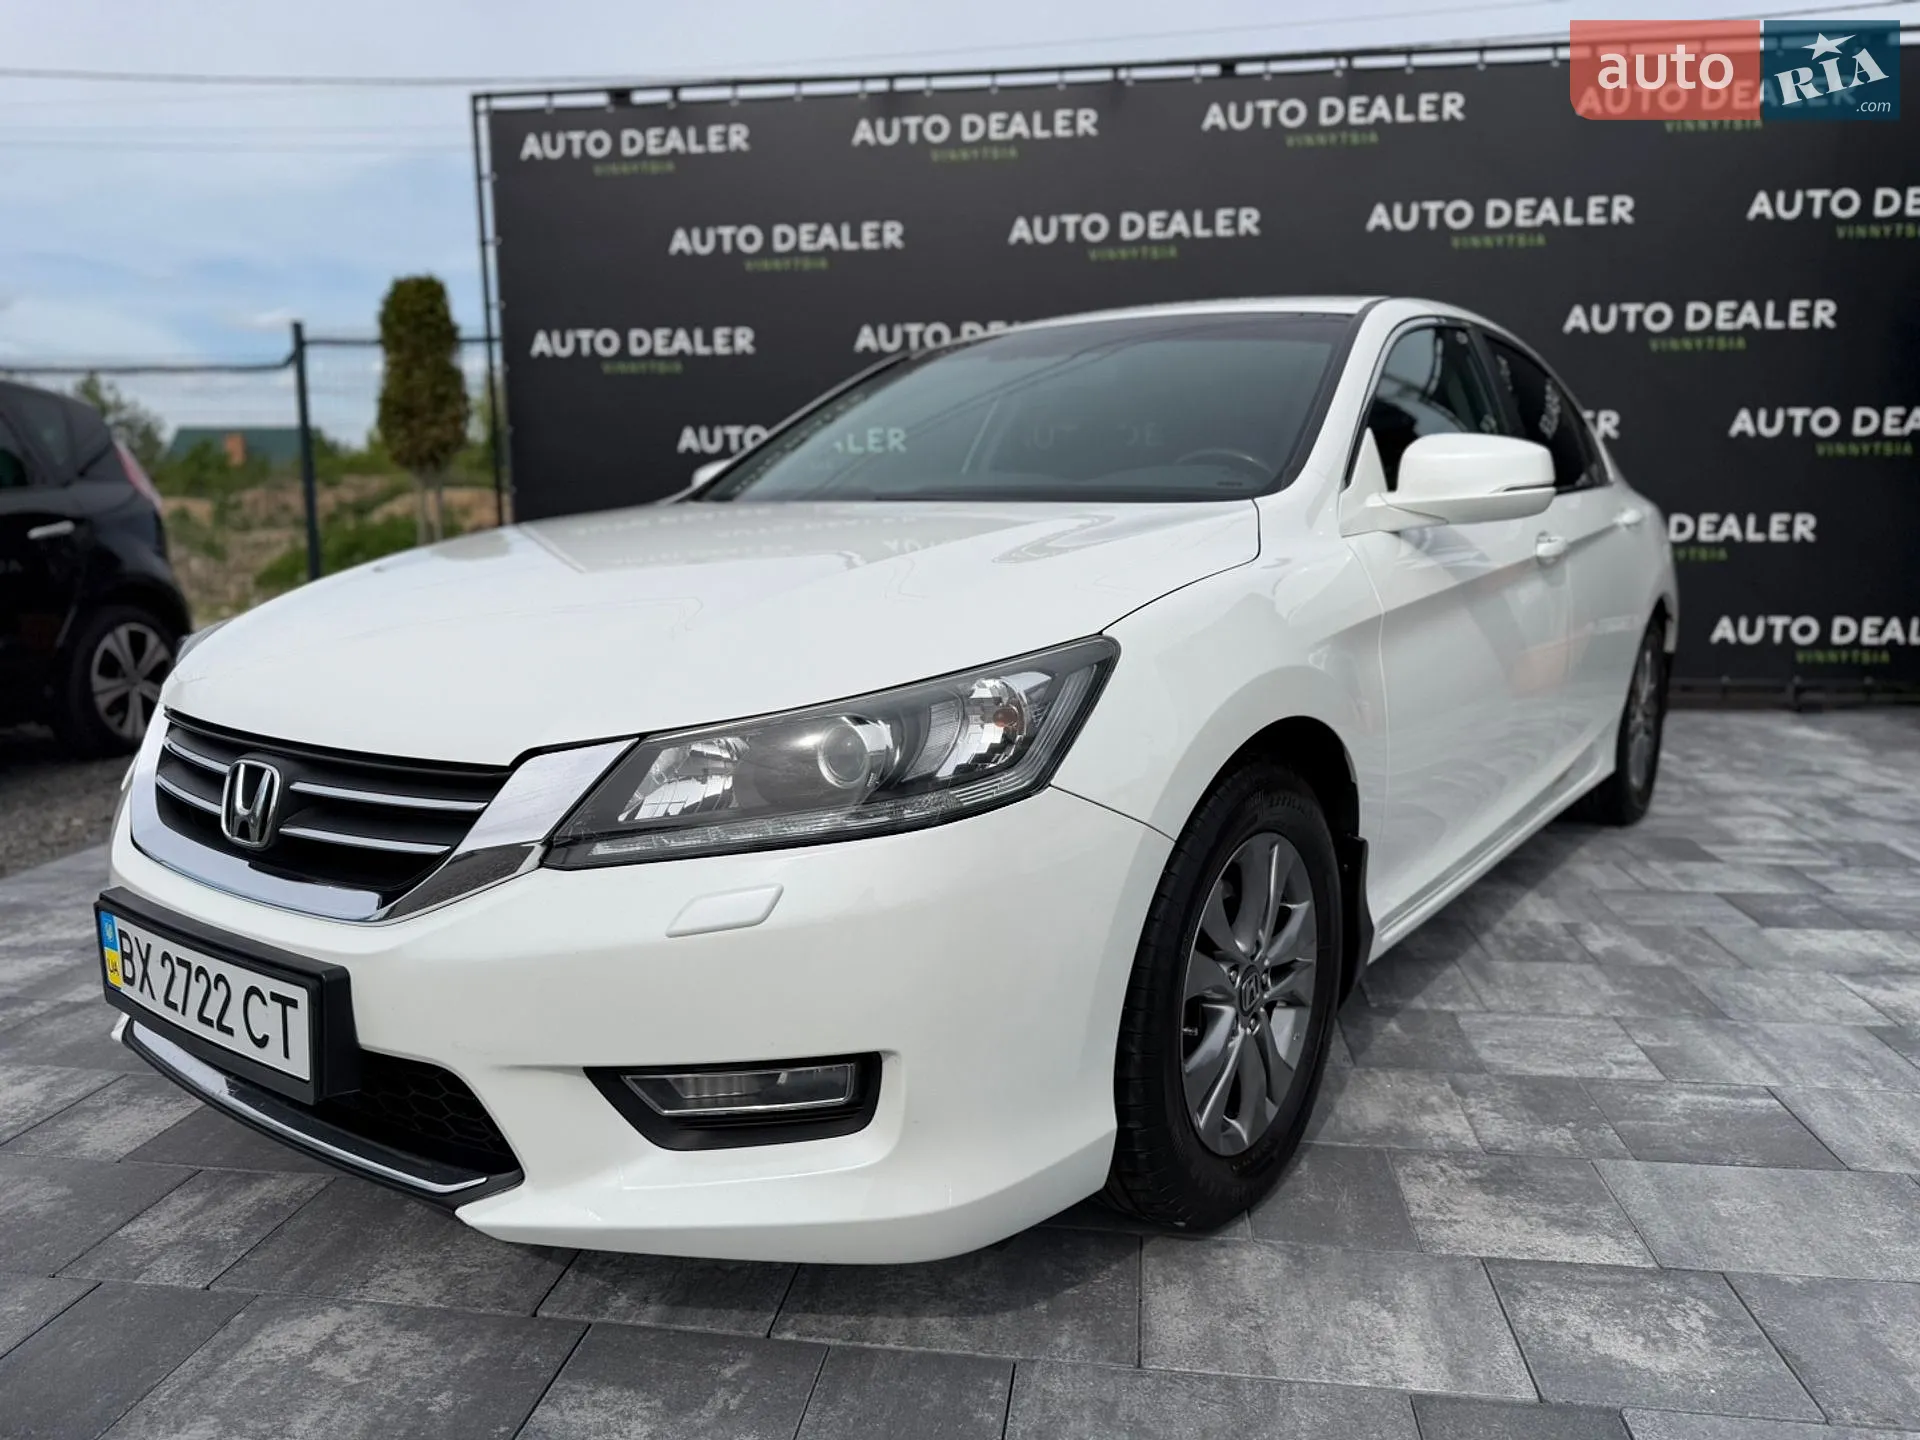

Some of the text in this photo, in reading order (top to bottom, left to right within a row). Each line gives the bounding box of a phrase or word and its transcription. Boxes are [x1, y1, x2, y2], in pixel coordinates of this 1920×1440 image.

[852, 108, 1097, 146] AUTO DEALER
[1202, 92, 1465, 131] AUTO DEALER
[521, 123, 749, 160] AUTO DEALER
[1366, 195, 1634, 231] AUTO DEALER
[1747, 188, 1860, 220] AUTO
[669, 221, 903, 255] AUTO DEALER
[1008, 207, 1260, 244] AUTO DEALER
[1563, 299, 1836, 333] AUTO DEALER
[531, 326, 754, 357] AUTO DEALER
[854, 322, 951, 352] AUTO
[1729, 407, 1840, 437] AUTO
[678, 425, 767, 454] AUTO
[1669, 512, 1816, 542] DEALER
[1711, 616, 1820, 645] AUTO
[118, 928, 298, 1059] BX 2722 CT
